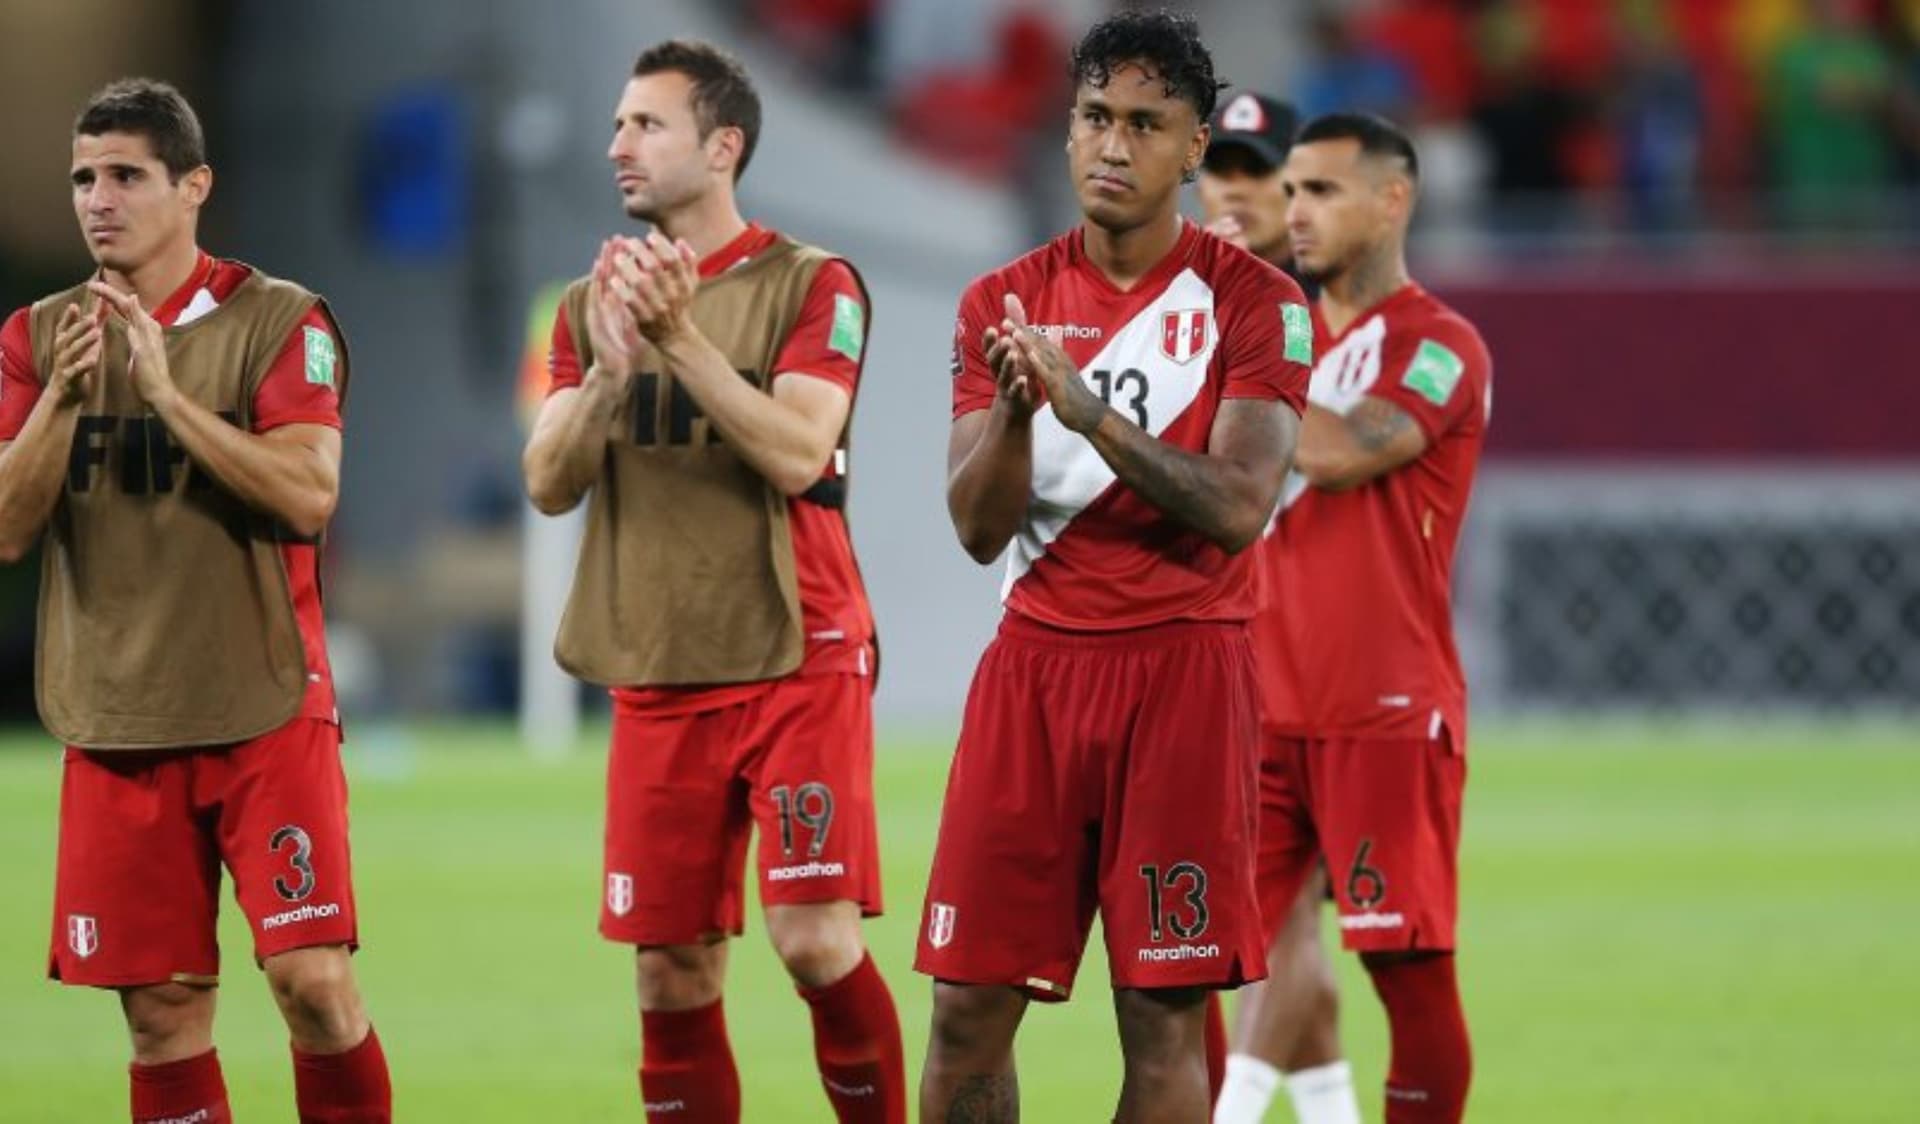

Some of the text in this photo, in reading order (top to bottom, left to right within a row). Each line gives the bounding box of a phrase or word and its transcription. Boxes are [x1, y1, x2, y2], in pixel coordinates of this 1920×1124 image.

[1091, 367, 1150, 433] 13
[70, 411, 237, 493] FIF
[770, 783, 835, 859] 19
[270, 825, 316, 902] 3
[767, 862, 845, 881] marathon
[1348, 838, 1386, 909] 6
[262, 903, 340, 931] marathon
[1139, 862, 1210, 942] 13
[1138, 944, 1220, 961] marathon
